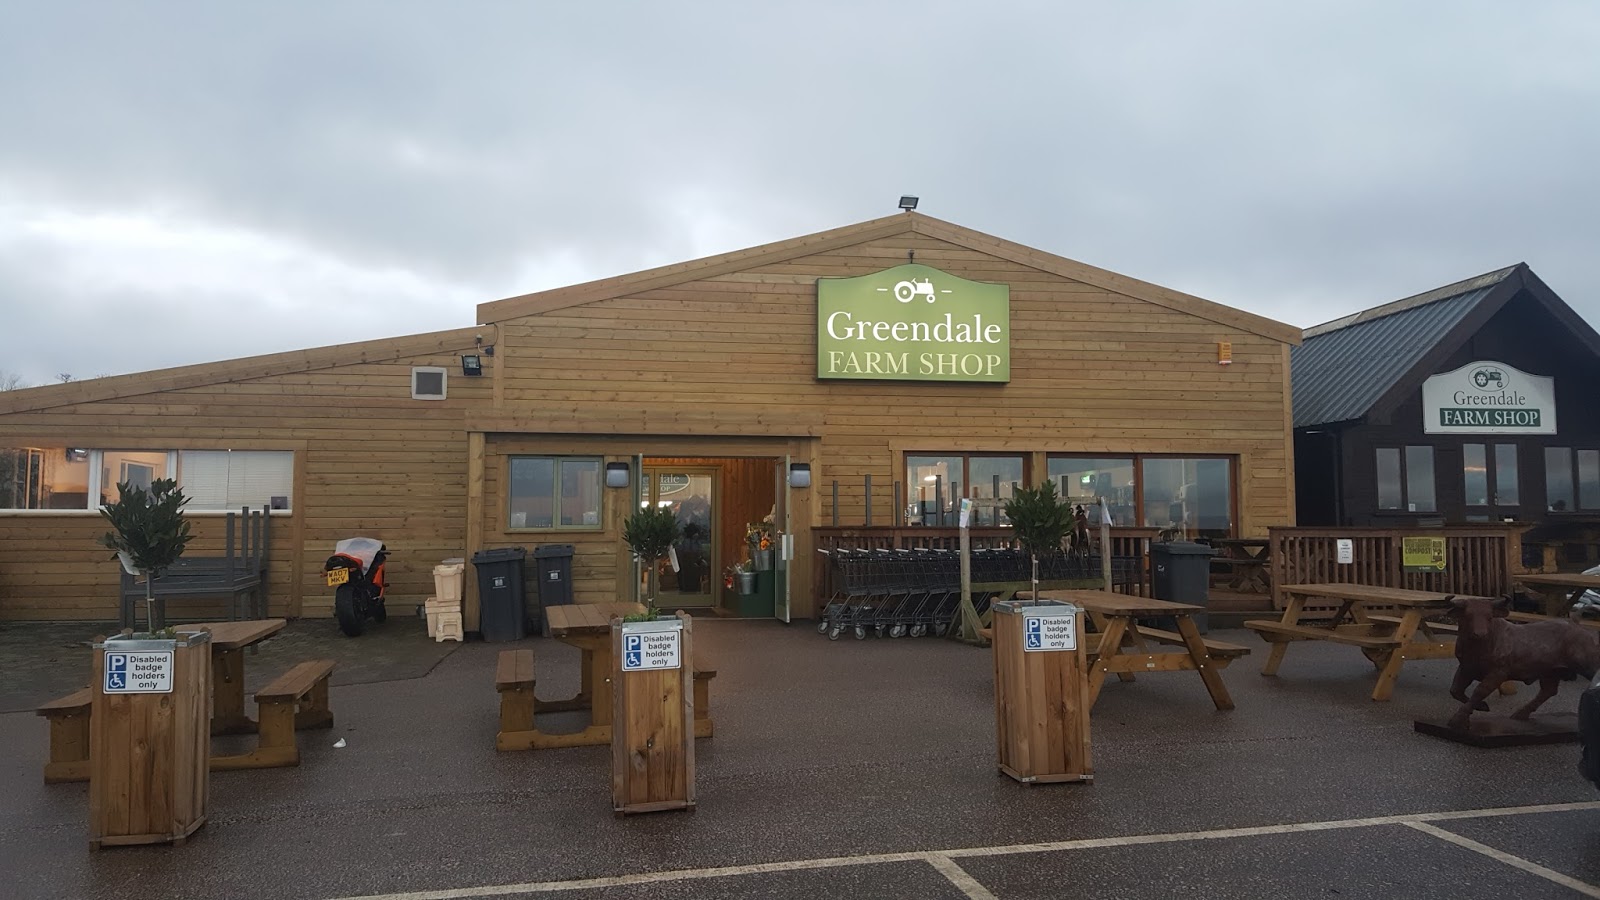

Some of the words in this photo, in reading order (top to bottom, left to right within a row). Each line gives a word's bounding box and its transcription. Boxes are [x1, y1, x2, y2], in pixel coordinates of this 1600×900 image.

[826, 311, 1001, 344] Greendale
[827, 351, 910, 375] FARM
[919, 352, 1001, 376] SHOP
[1453, 390, 1526, 406] Greendale
[1443, 410, 1491, 425] FARM
[1494, 410, 1539, 426] SHOP
[1404, 547, 1431, 555] COMPOST
[1042, 618, 1071, 626] Disabled
[1046, 625, 1068, 634] badge
[643, 634, 675, 643] Disabled
[648, 642, 672, 650] badge
[1050, 640, 1065, 648] only
[645, 650, 674, 658] holders
[130, 655, 168, 663] Disabled
[651, 658, 668, 666] only
[135, 664, 163, 672] badge
[131, 672, 165, 680] holders
[138, 681, 158, 689] only
